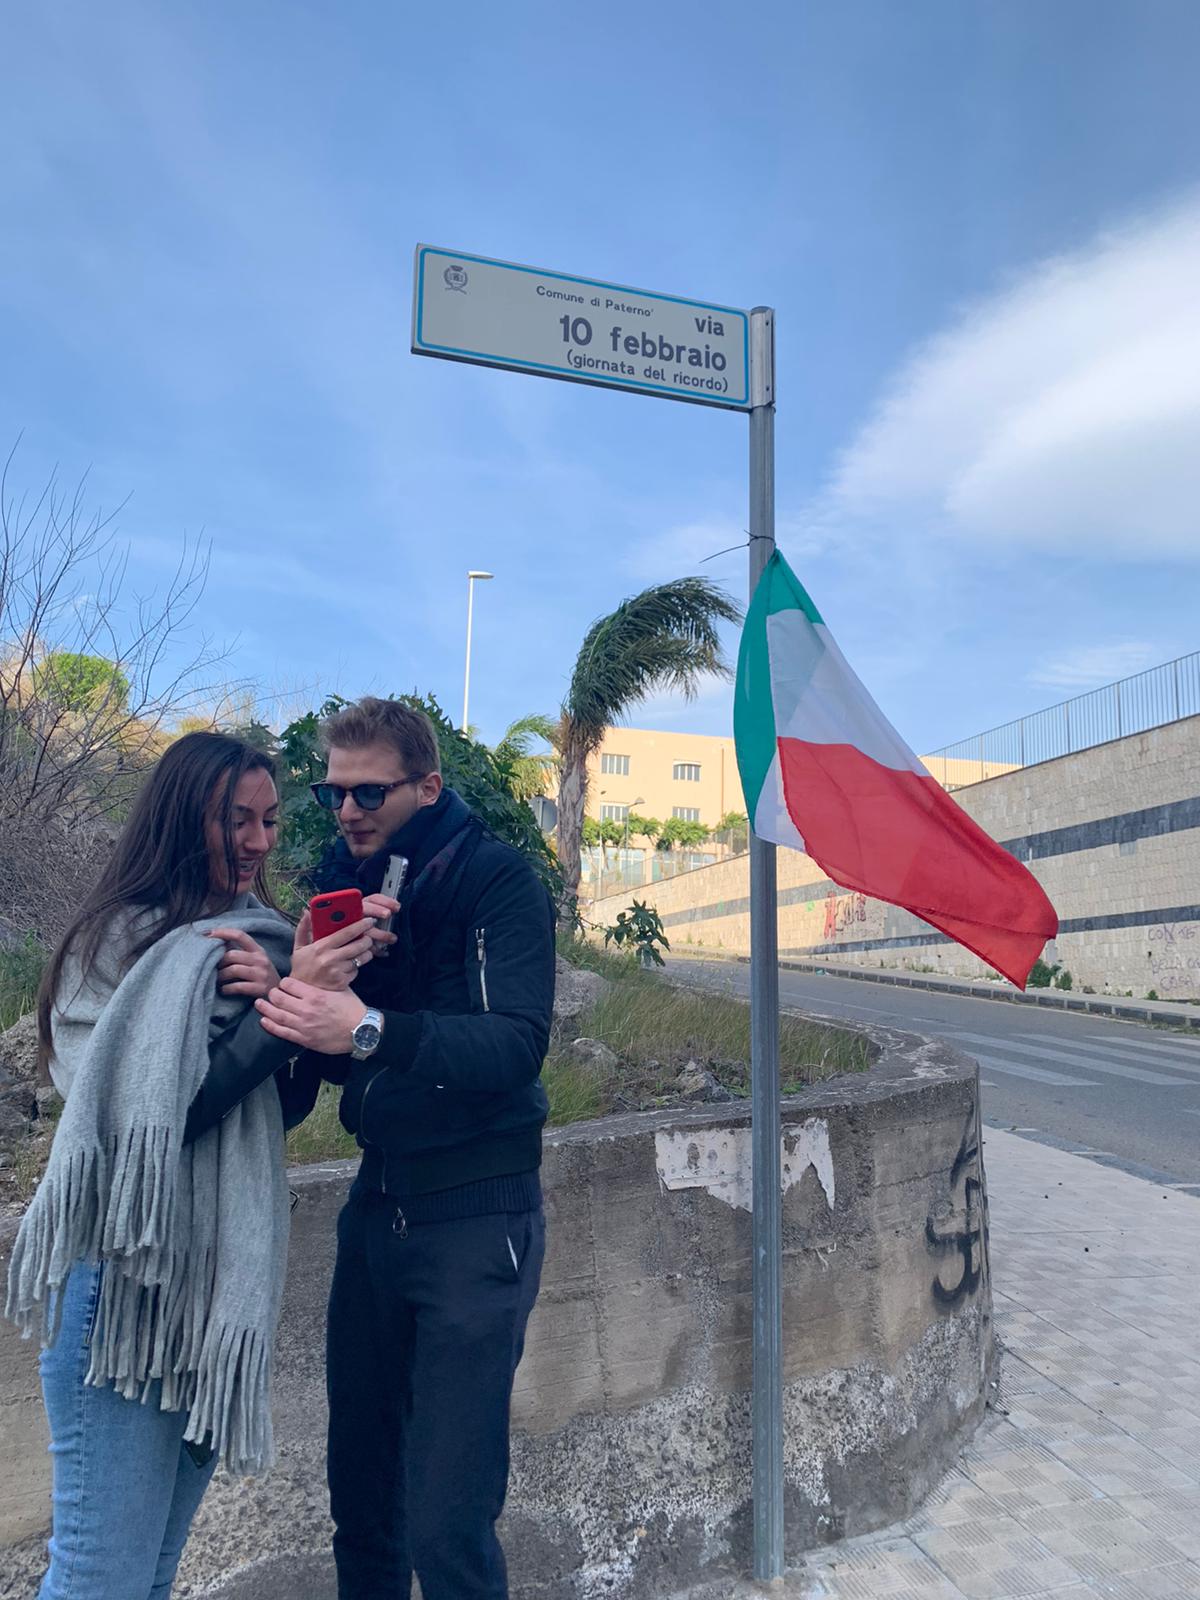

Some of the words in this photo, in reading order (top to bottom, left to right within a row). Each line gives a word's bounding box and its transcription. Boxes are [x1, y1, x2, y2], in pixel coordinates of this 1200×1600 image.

[536, 285, 584, 304] Comune
[590, 298, 601, 307] di
[695, 315, 725, 336] via
[559, 314, 593, 346] 10
[609, 326, 727, 372] febbraio
[566, 349, 635, 376] (giornata
[643, 365, 666, 382] del
[673, 371, 728, 393] ricordo)
